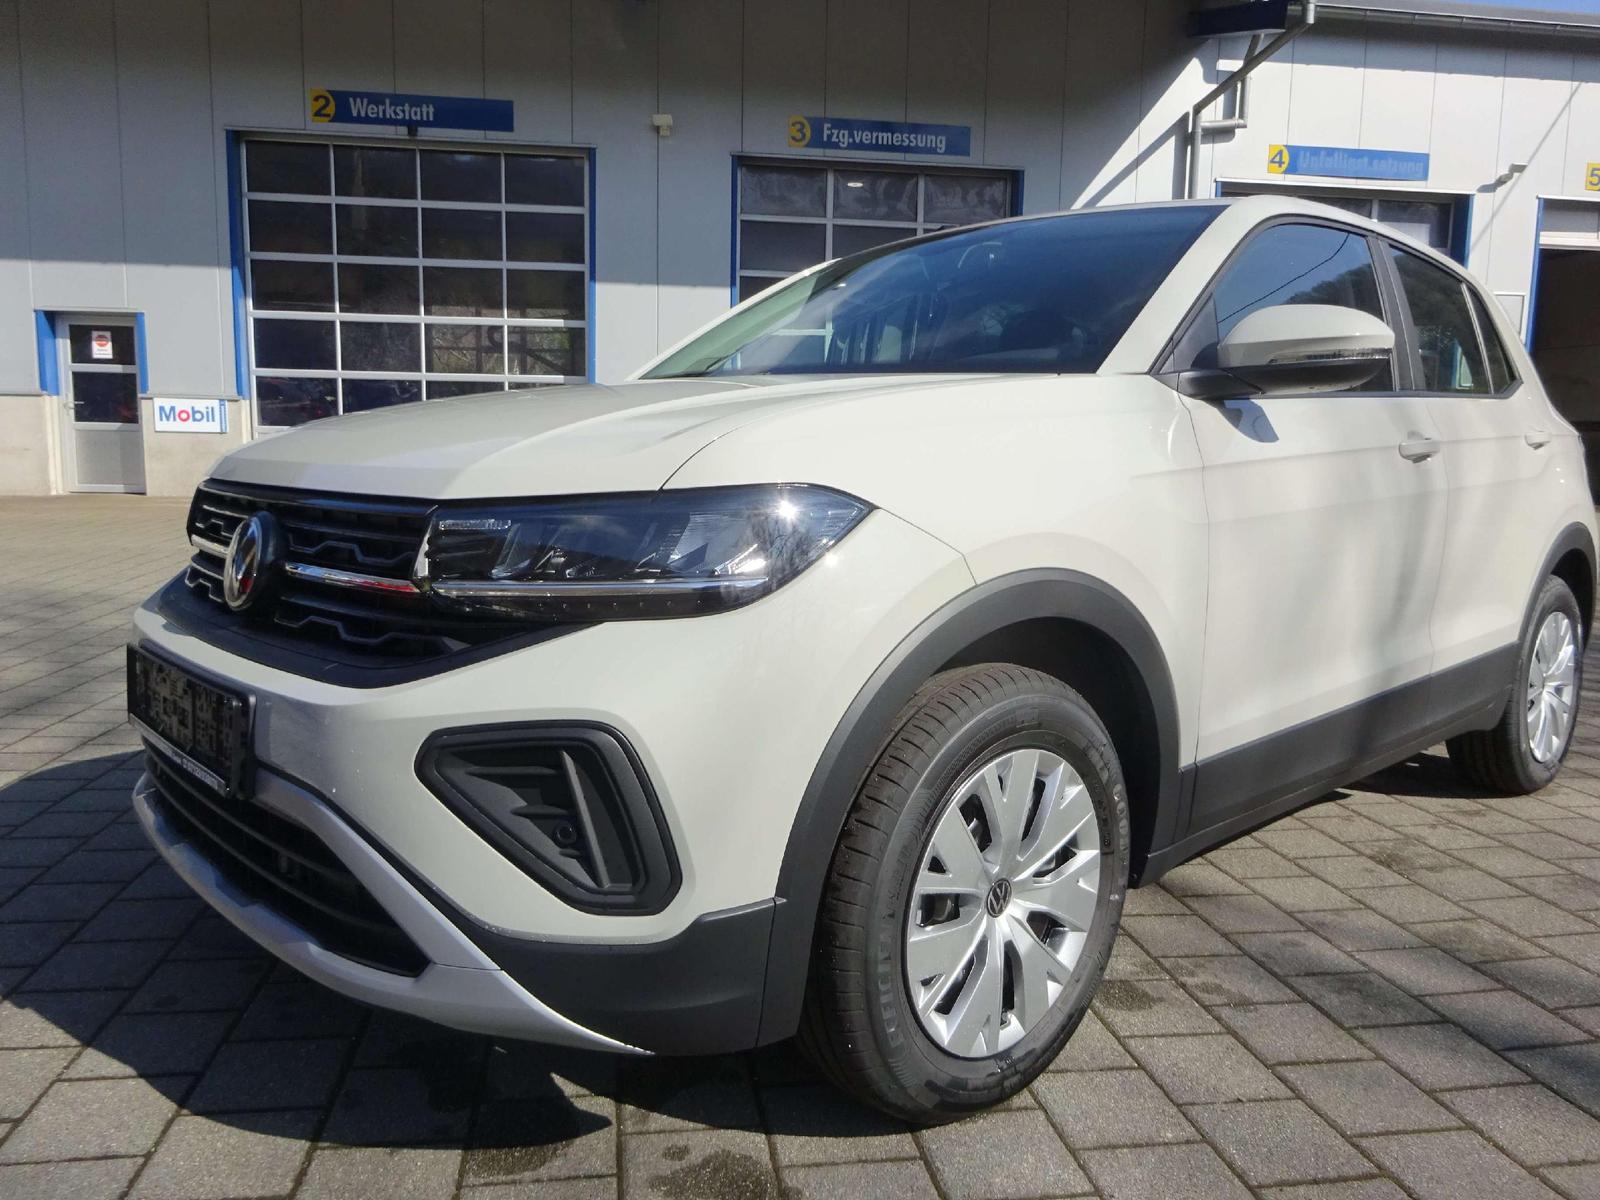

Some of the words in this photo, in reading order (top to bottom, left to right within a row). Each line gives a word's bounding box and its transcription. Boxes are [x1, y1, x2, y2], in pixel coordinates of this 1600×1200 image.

[312, 95, 331, 118] 2
[349, 97, 435, 121] Werkstatt
[790, 121, 806, 143] 3
[823, 123, 946, 153] Fzg.vermessung
[1269, 149, 1285, 168] 4
[1589, 167, 1600, 186] 5
[158, 405, 216, 422] Mobil
